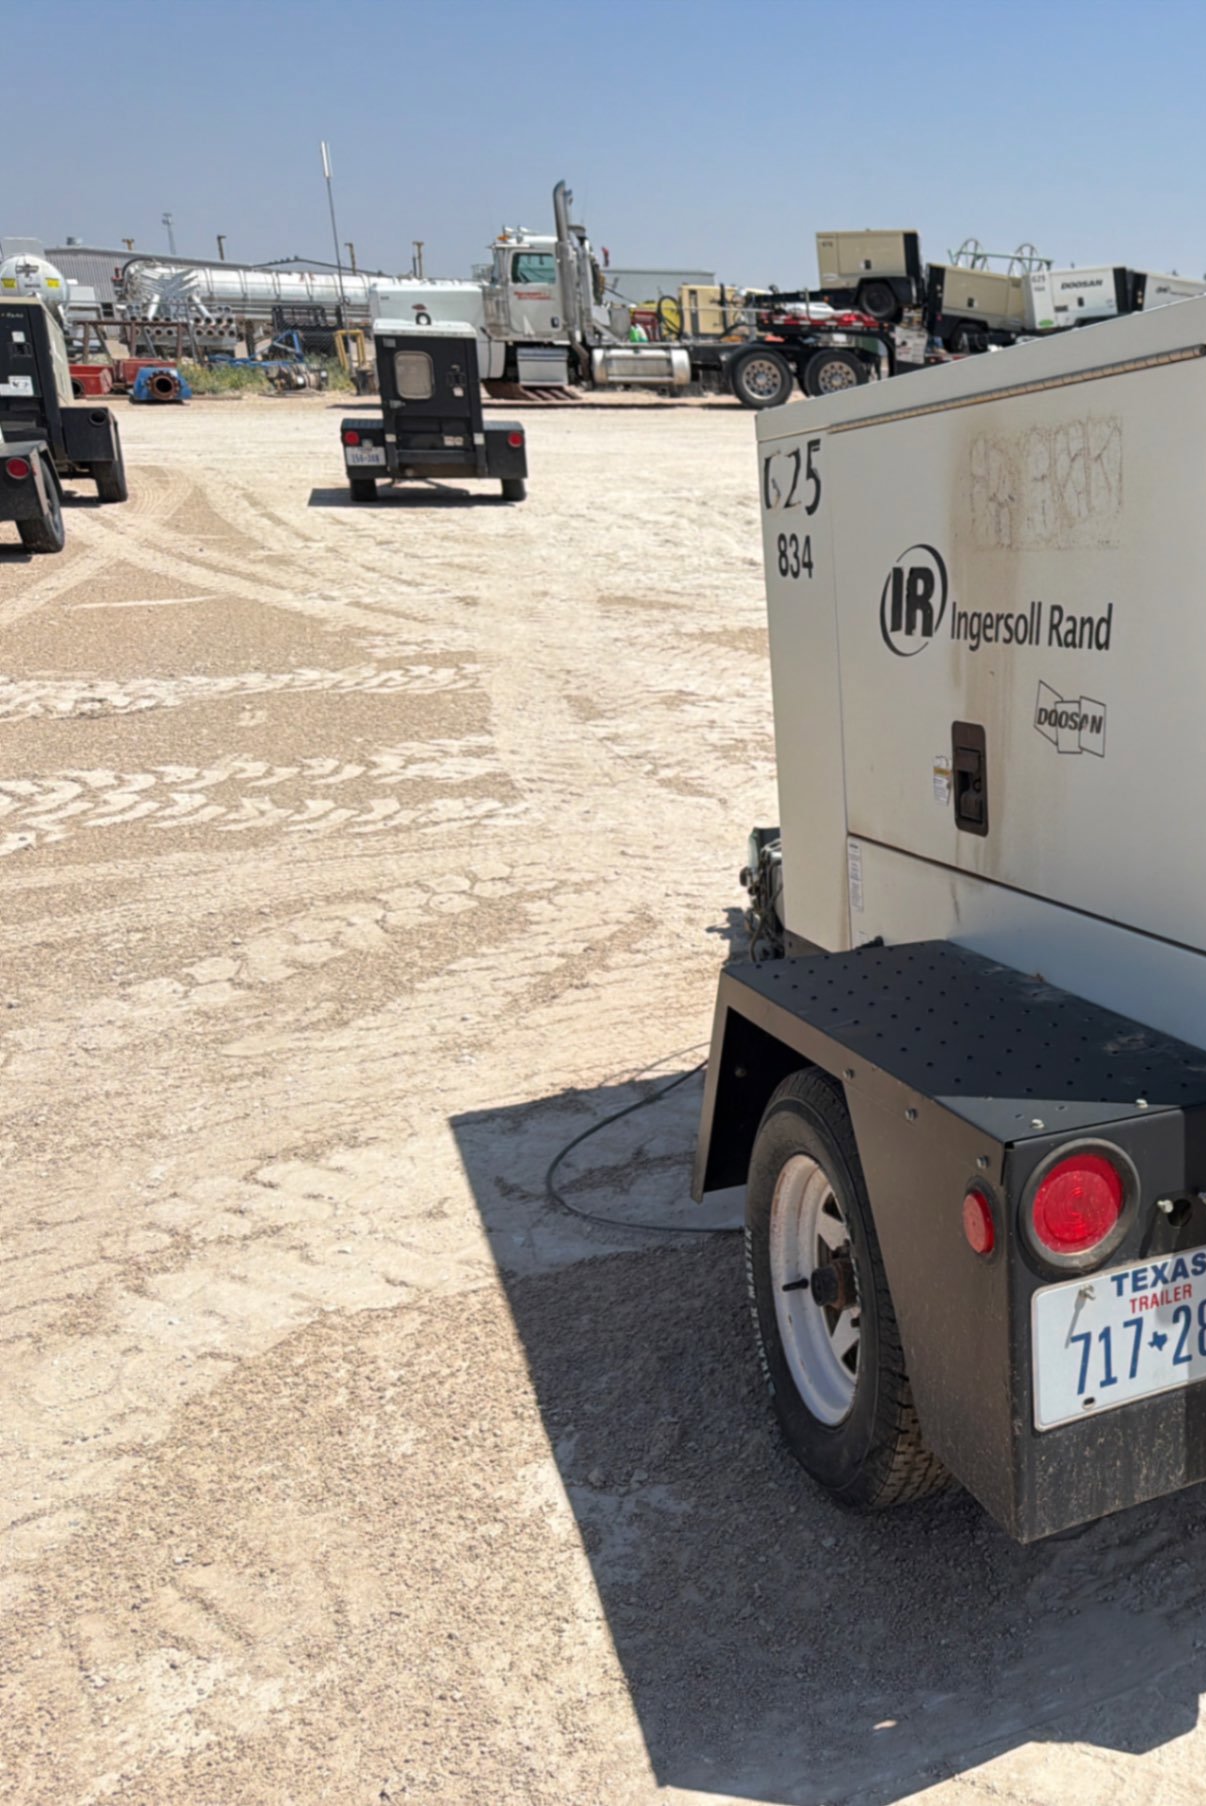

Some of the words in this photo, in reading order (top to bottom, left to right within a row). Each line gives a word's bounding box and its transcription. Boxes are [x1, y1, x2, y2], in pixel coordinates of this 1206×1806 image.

[1061, 279, 1103, 290] DOOSAN
[777, 533, 813, 579] 834
[890, 566, 934, 638] IR
[951, 601, 1041, 651] Ingersoll
[1047, 602, 1113, 651] Rand
[1037, 707, 1103, 734] DOOSAN
[1111, 1252, 1206, 1297] TEXAS
[1129, 1283, 1192, 1314] TRAILER
